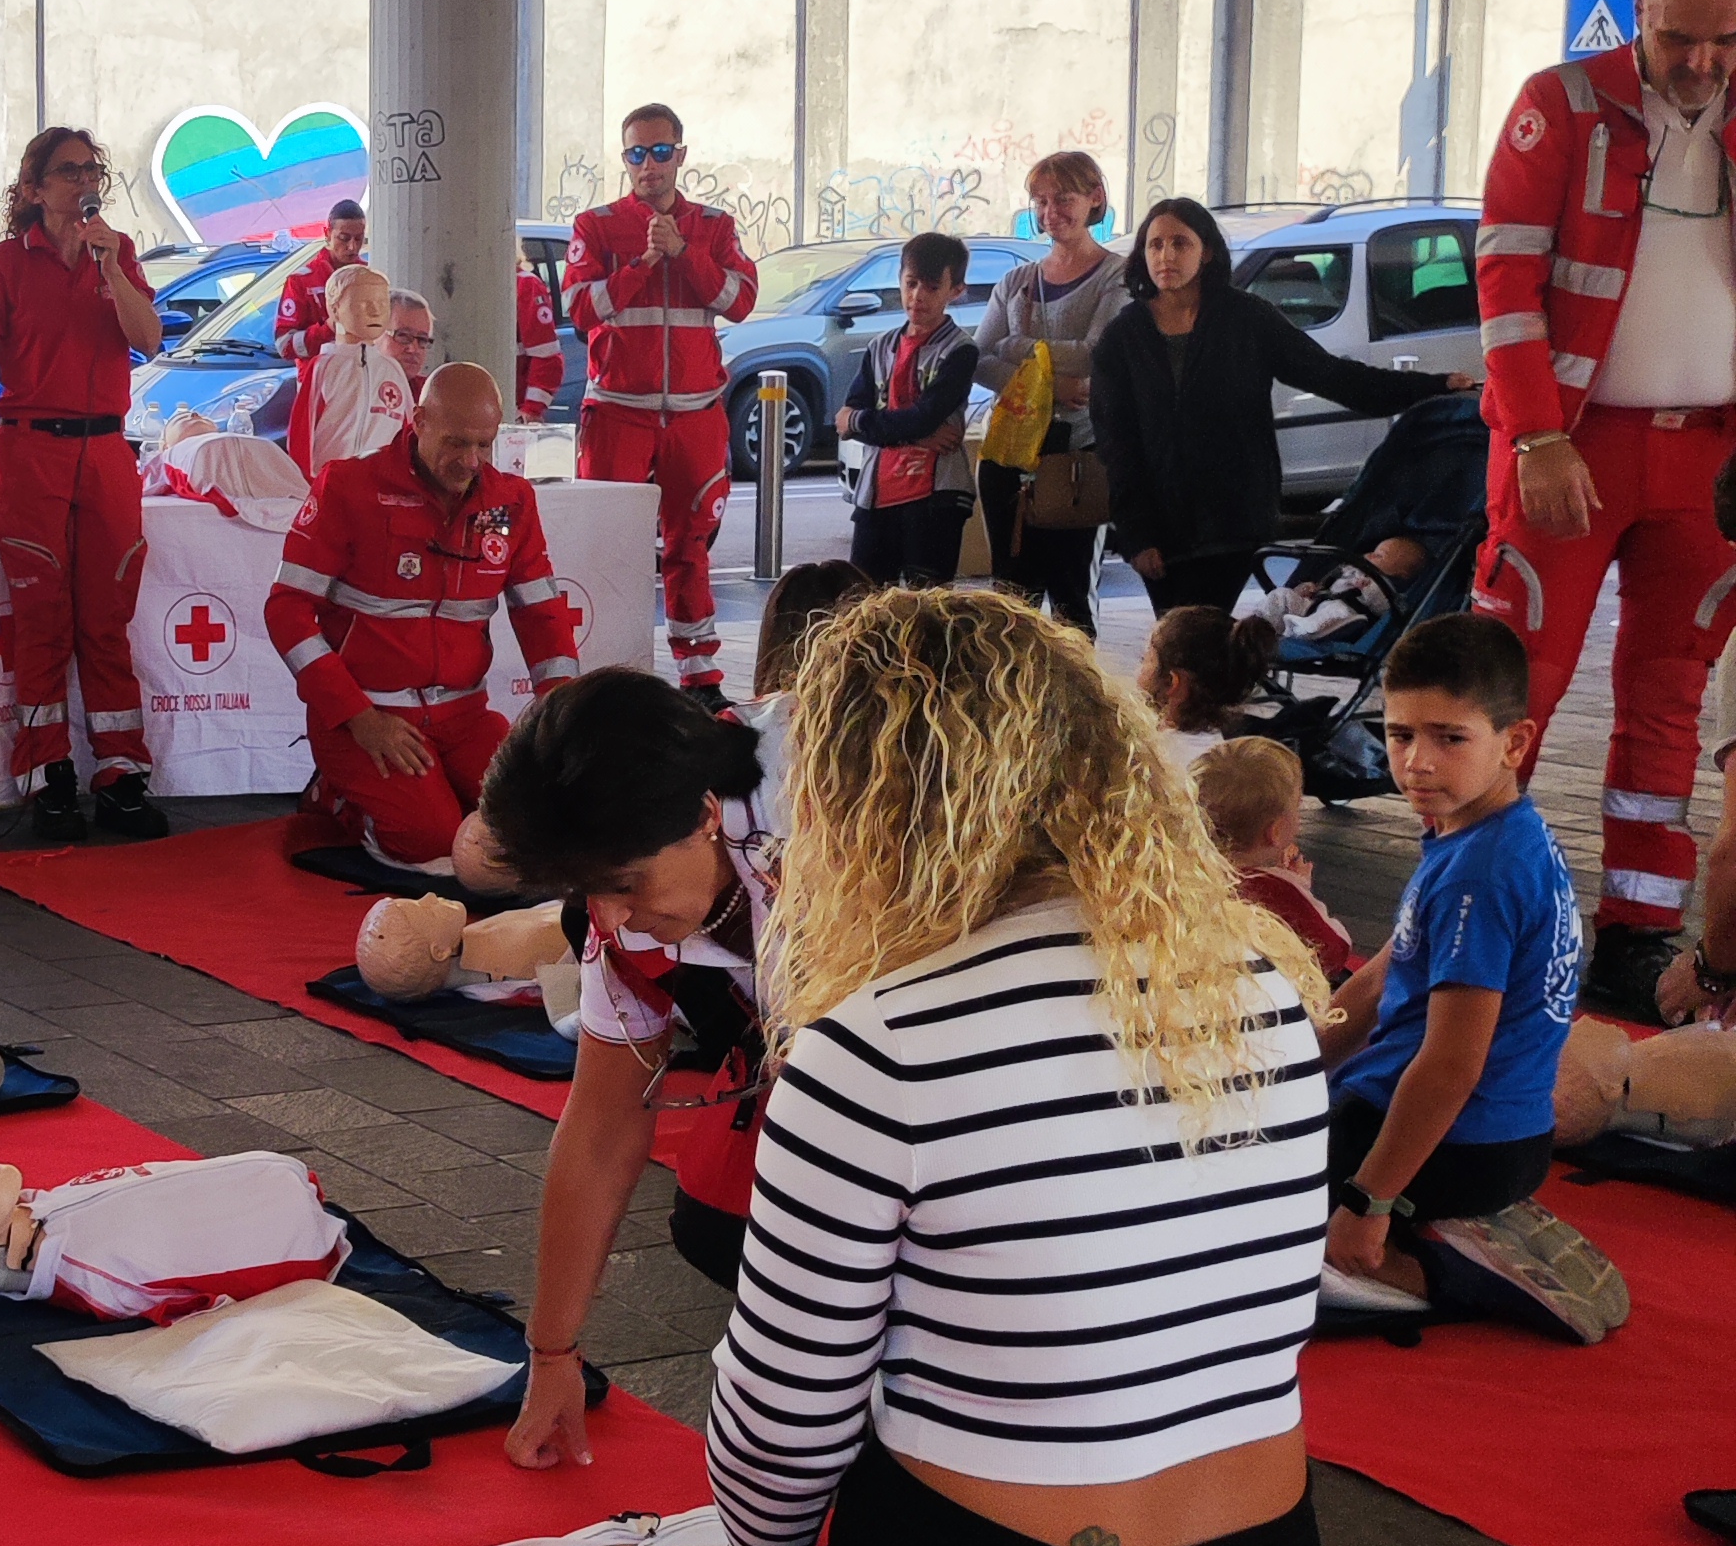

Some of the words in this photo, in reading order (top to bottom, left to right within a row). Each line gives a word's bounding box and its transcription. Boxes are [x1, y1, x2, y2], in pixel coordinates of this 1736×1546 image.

[511, 677, 534, 695] CROC
[151, 693, 179, 712] CROCE
[183, 693, 212, 712] ROSSA
[215, 692, 251, 711] ITALIANA
